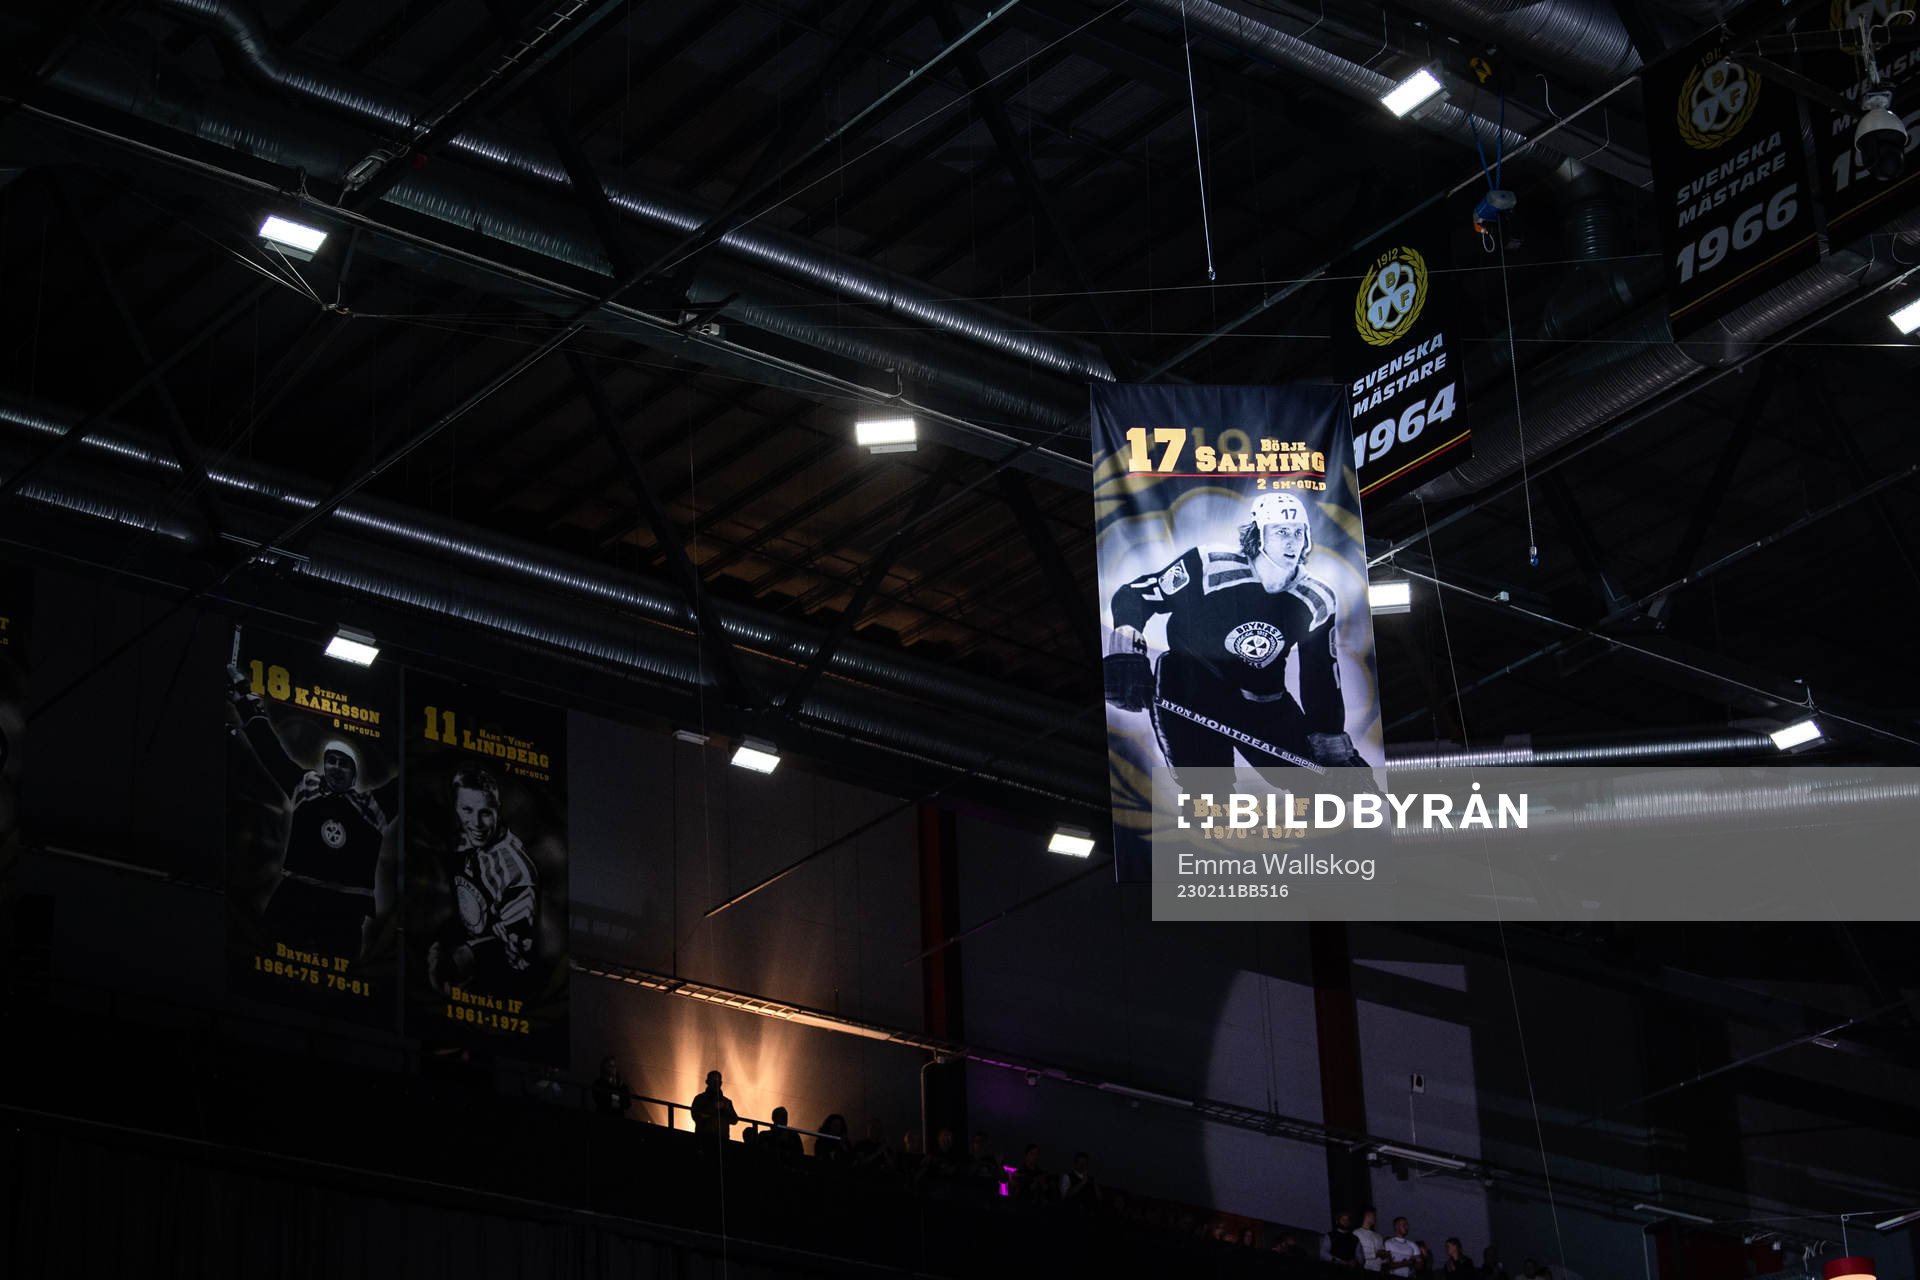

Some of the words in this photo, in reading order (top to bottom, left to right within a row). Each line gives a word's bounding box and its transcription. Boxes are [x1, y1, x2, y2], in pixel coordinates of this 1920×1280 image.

[1677, 130, 1783, 206] SVENSKA
[1677, 151, 1786, 229] MÄSTARE
[1676, 183, 1799, 286] 1966
[1376, 247, 1399, 269] 1912
[1351, 332, 1444, 398] SVENSKA
[1352, 352, 1447, 419] MÄSTARE
[1352, 382, 1456, 470] 1964
[1126, 427, 1187, 472] 17
[1195, 446, 1326, 472] SALMING
[1256, 478, 1267, 490] 2
[1272, 481, 1327, 491] SM-GULD
[1280, 508, 1297, 520] 17
[249, 659, 291, 701] 18
[294, 687, 381, 724] KARLSSON
[424, 705, 458, 746] 11
[463, 729, 551, 769] LINDBERG
[1193, 713, 1279, 755] MONTREAL
[255, 955, 320, 984] 1964-75
[333, 956, 351, 972] IF
[447, 1004, 529, 1034] 1961-1972
[507, 998, 523, 1014] IF
